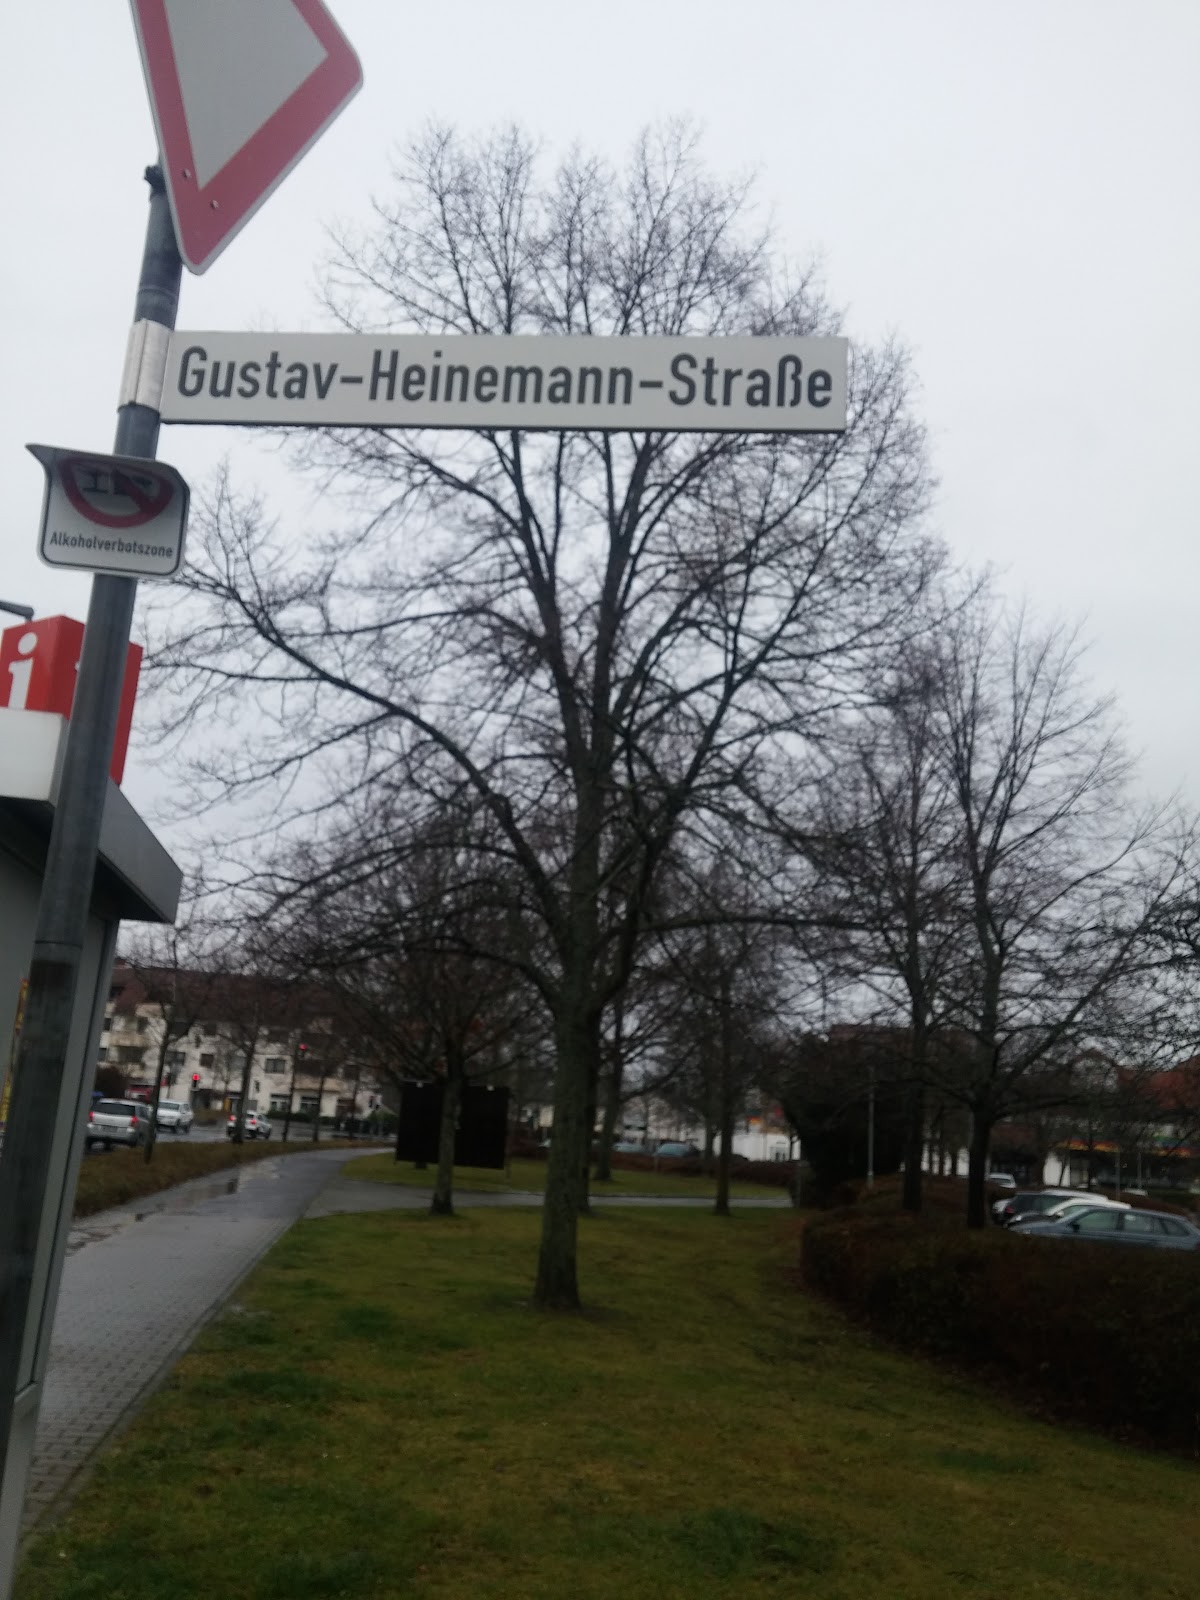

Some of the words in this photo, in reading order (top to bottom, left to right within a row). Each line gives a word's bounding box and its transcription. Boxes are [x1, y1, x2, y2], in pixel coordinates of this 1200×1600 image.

[177, 345, 833, 408] Gustav-Heinemann-Straße
[50, 531, 174, 558] Alkoholverbotszone
[7, 631, 38, 710] i
